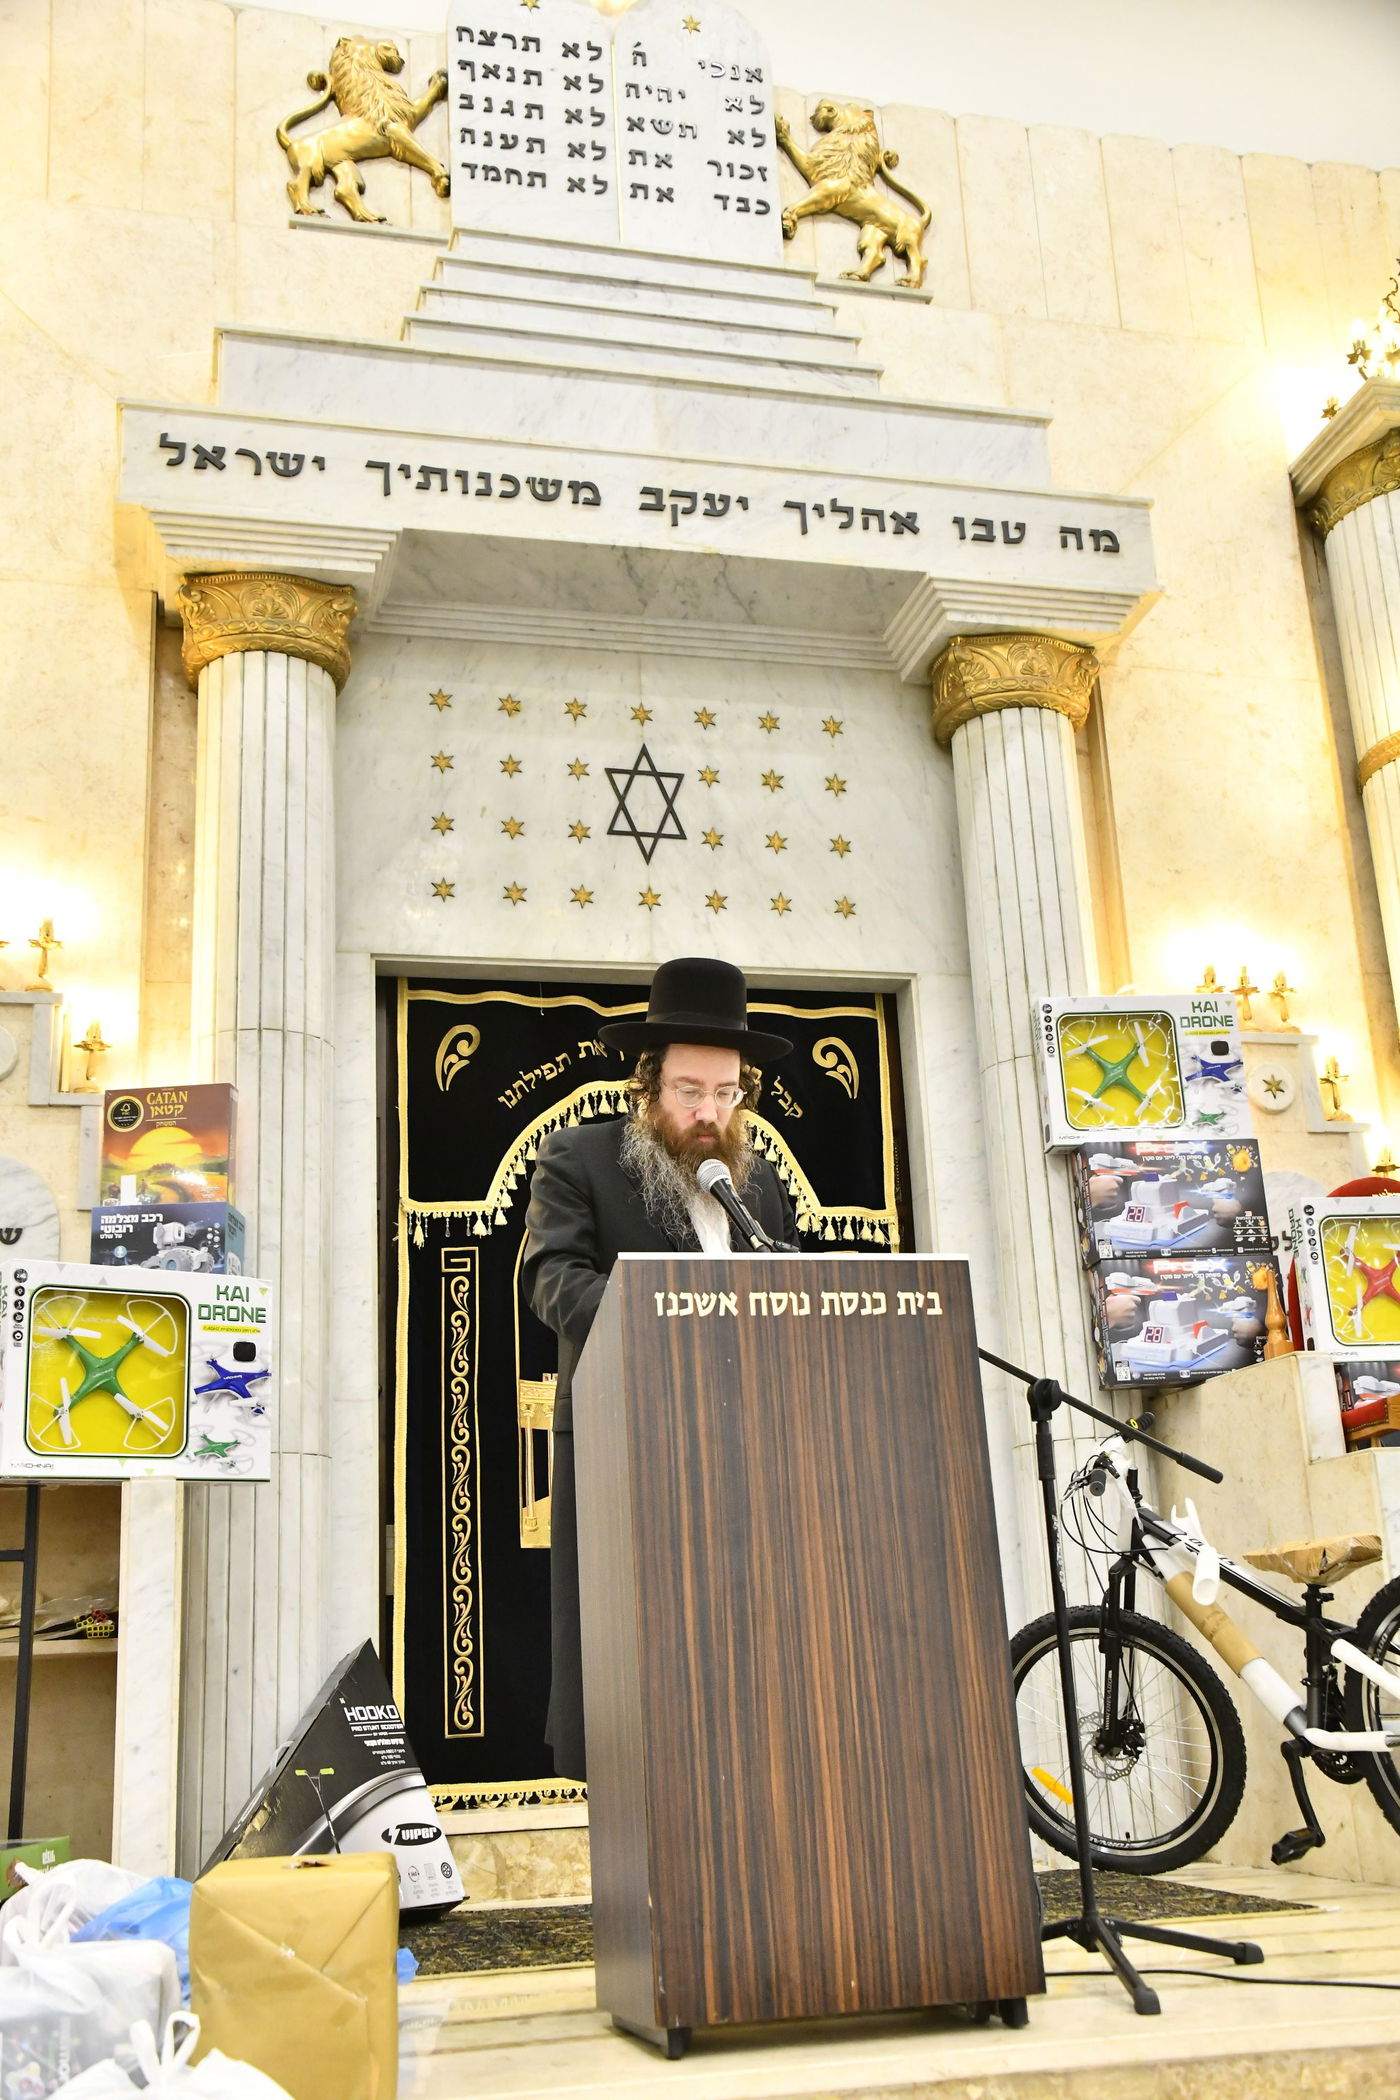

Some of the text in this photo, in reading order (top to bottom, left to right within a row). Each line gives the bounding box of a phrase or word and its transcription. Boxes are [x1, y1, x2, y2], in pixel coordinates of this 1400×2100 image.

[456, 25, 603, 61] לא תרצח
[458, 59, 604, 94] לא תנאף
[698, 59, 764, 83] אנכי
[459, 92, 606, 127] לא תגנב
[625, 81, 766, 116] לא יהיה
[460, 127, 607, 161] לא תענה
[626, 114, 767, 149] לא תשא
[461, 161, 609, 195] לא תחמד
[628, 149, 768, 182] זכור את
[629, 181, 771, 216] כבד את
[160, 432, 1120, 553] מה טבו אהליך יעקב משכנותיך ישראל
[1180, 1014, 1234, 1028] DRONE
[1191, 1001, 1219, 1013] KAI
[497, 1052, 572, 1109] תפילתנו
[146, 1091, 188, 1105] CATAN
[149, 1104, 184, 1118] קטאן
[770, 1075, 804, 1119] קבל
[101, 1214, 163, 1224] רכב מצלמה
[1127, 1207, 1145, 1222] 28
[216, 1284, 250, 1303] KAI
[654, 1290, 943, 1317] בית כנסת נוסח אשכנז
[197, 1303, 267, 1324] DRONE
[1145, 1327, 1163, 1343] 28
[343, 1704, 400, 1722] HOOKO
